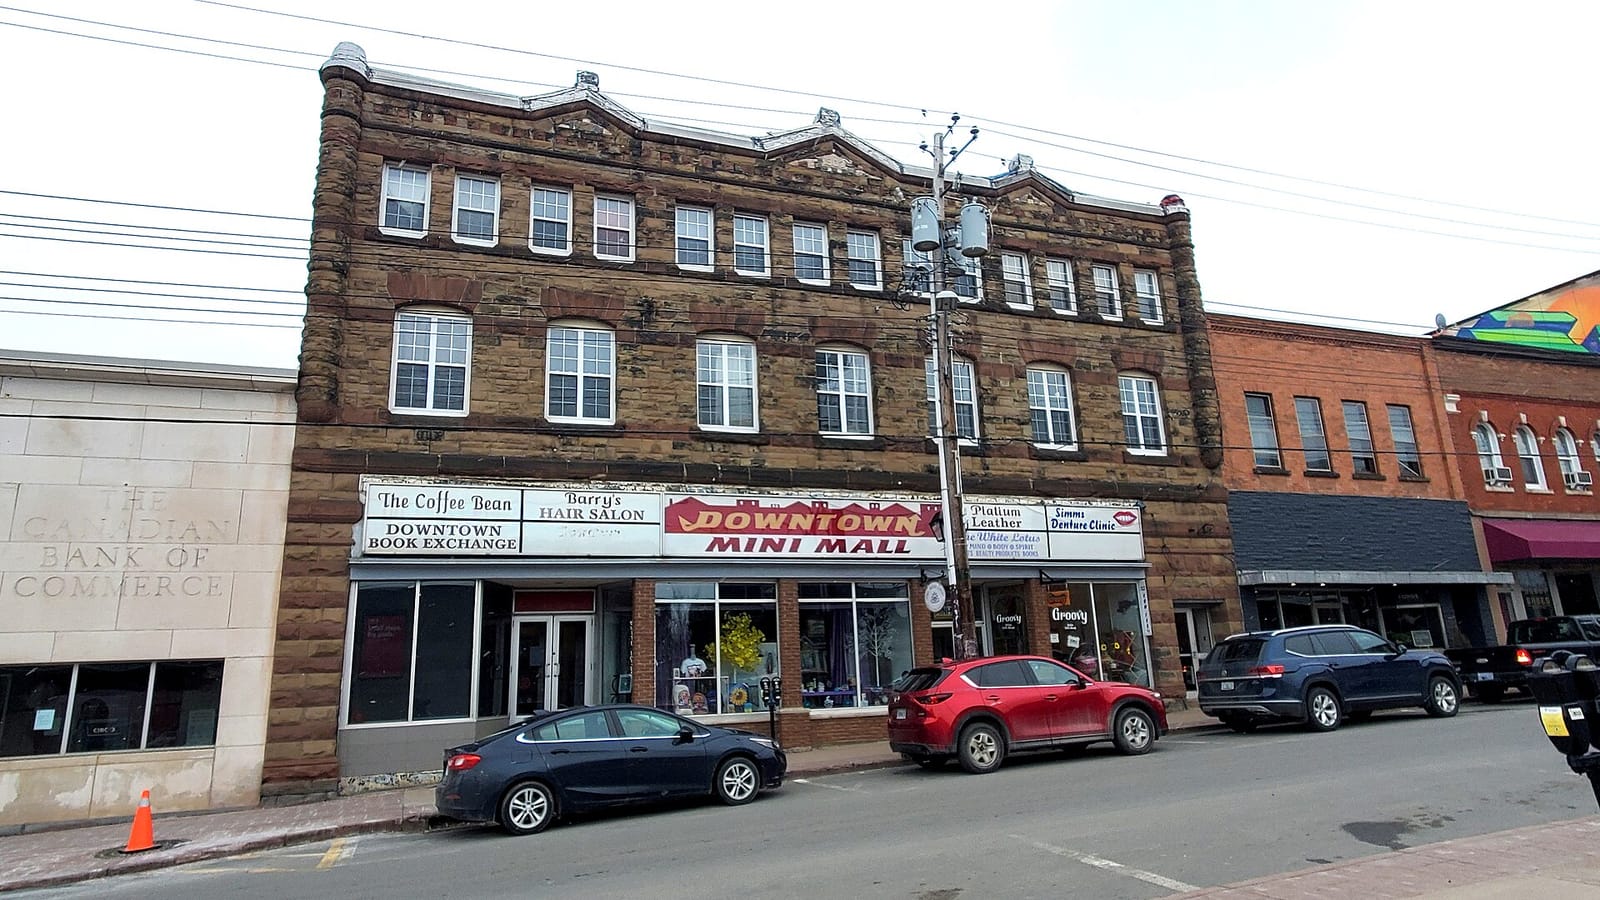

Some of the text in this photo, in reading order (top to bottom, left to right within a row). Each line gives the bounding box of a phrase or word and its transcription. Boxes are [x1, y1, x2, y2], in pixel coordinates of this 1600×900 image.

[99, 490, 168, 512] THE
[378, 490, 512, 514] The Coffee Bean
[564, 491, 621, 508] Barry's
[540, 507, 645, 521] HAIR SALON
[1055, 507, 1085, 519] Simms
[386, 523, 501, 537] DOWNTOWN
[678, 510, 926, 537] DOWNTOWN
[971, 516, 1022, 528] Leather
[1050, 518, 1116, 531] Denture Clinic
[367, 537, 517, 550] BOOK EXCHANGE
[704, 538, 912, 554] MINI MALL
[39, 546, 209, 569] BANK OF
[14, 575, 223, 599] COMMERCE
[996, 613, 1022, 625] Groovy
[1052, 607, 1088, 625] Groovy
